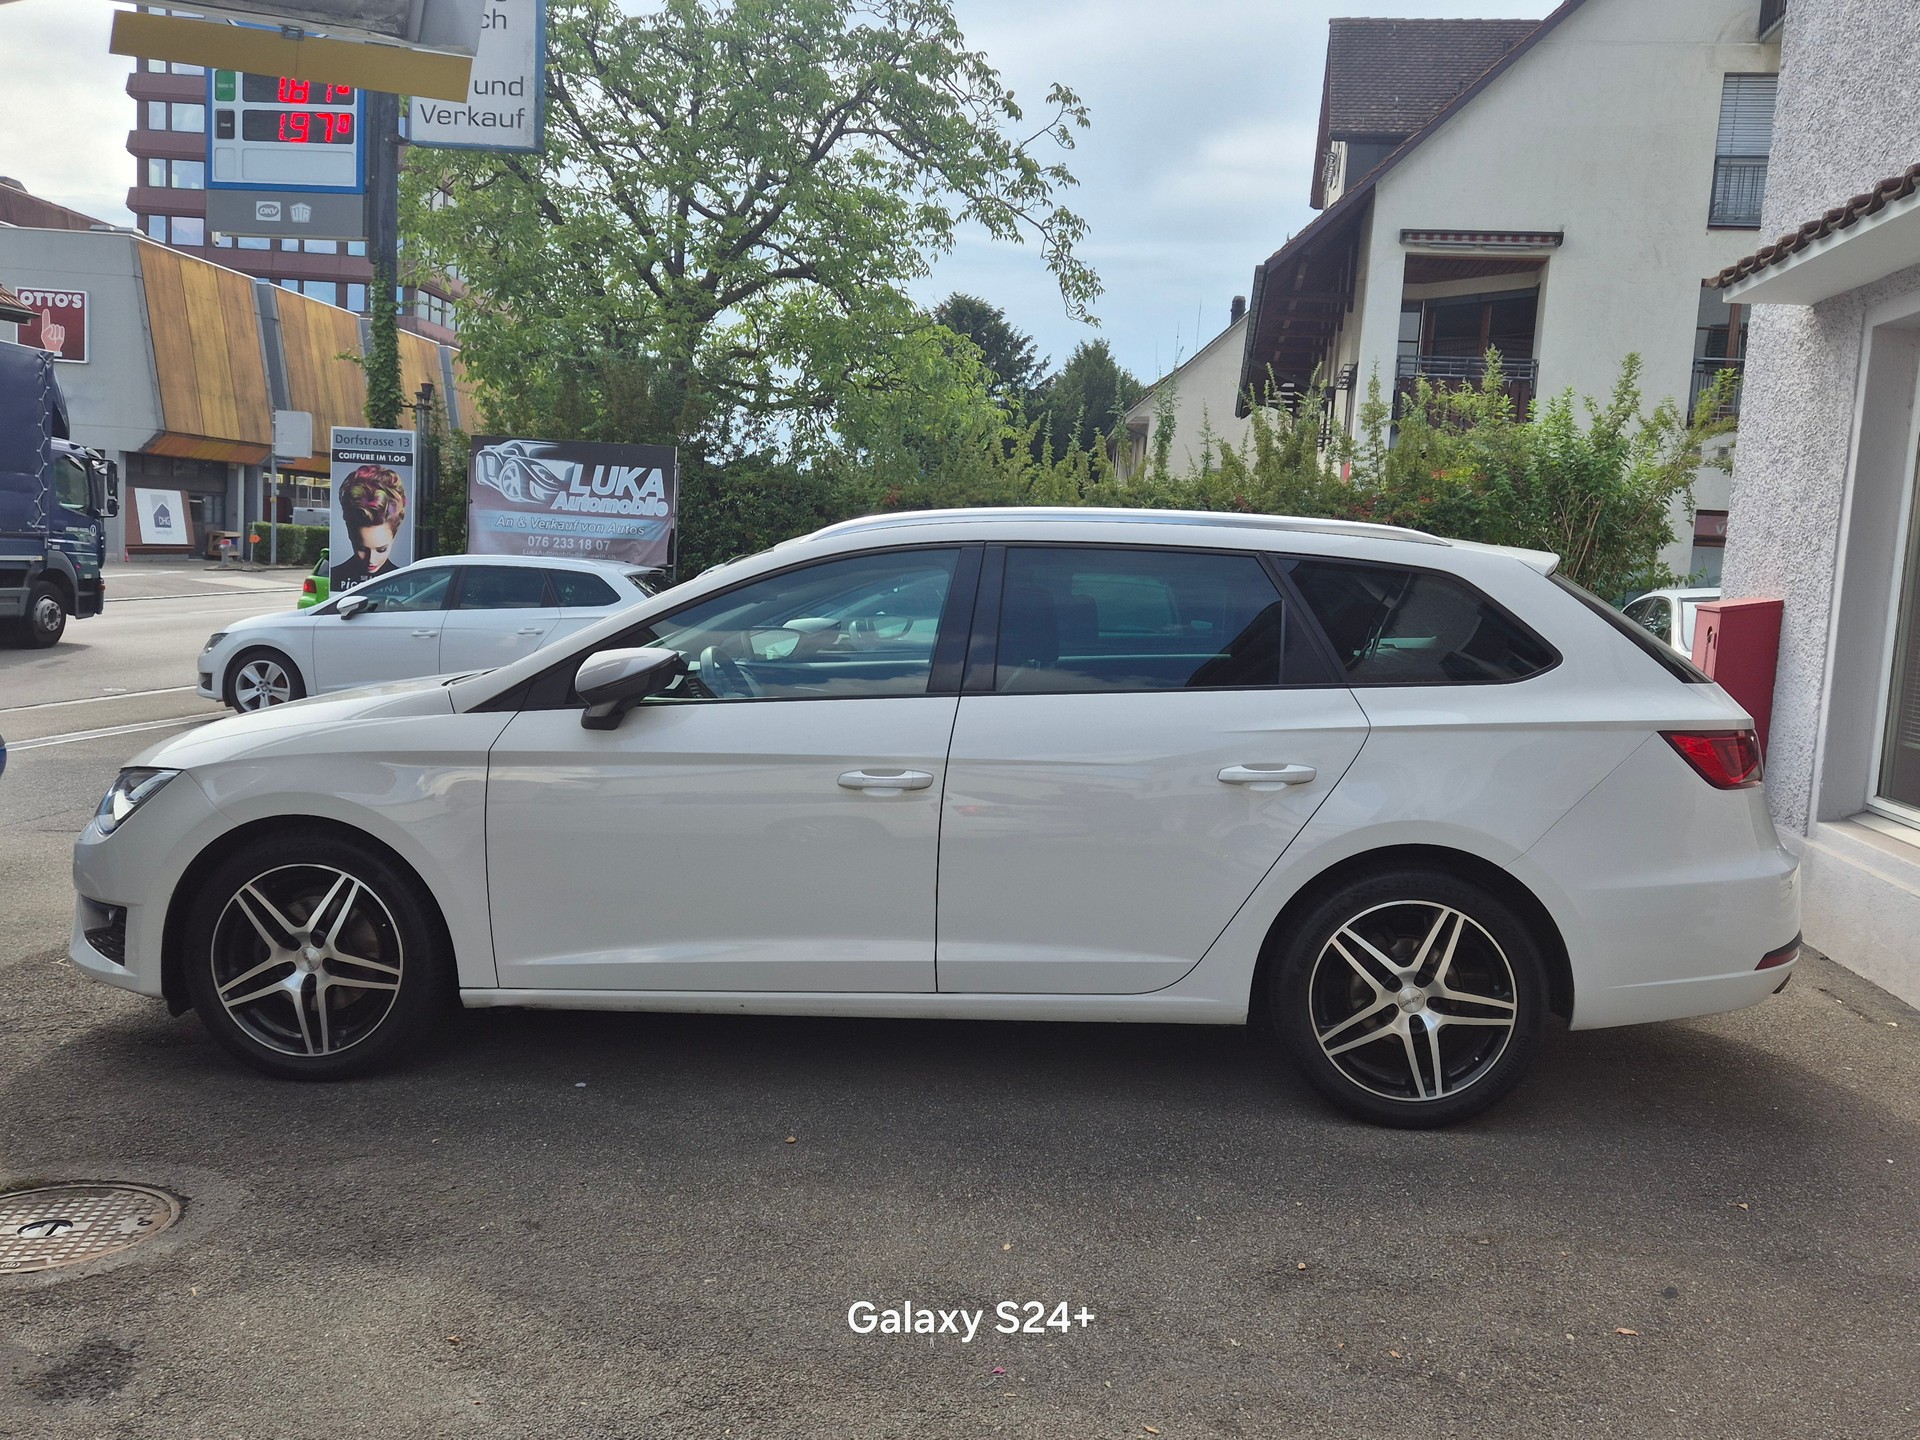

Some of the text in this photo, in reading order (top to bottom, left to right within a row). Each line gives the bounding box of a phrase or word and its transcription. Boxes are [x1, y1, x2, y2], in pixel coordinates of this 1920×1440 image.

[474, 75, 524, 97] und
[420, 103, 526, 129] Verkauf
[259, 207, 278, 215] DKV
[20, 291, 82, 309] OTTO'S
[335, 434, 410, 448] Dorfstrasse 13
[338, 452, 375, 461] COIFFURE
[376, 454, 386, 462] IM
[569, 463, 665, 499] LUKA
[550, 490, 669, 518] Automobile
[496, 515, 646, 536] An & Verkauf von Autos
[528, 535, 611, 551] 076 233 18 07
